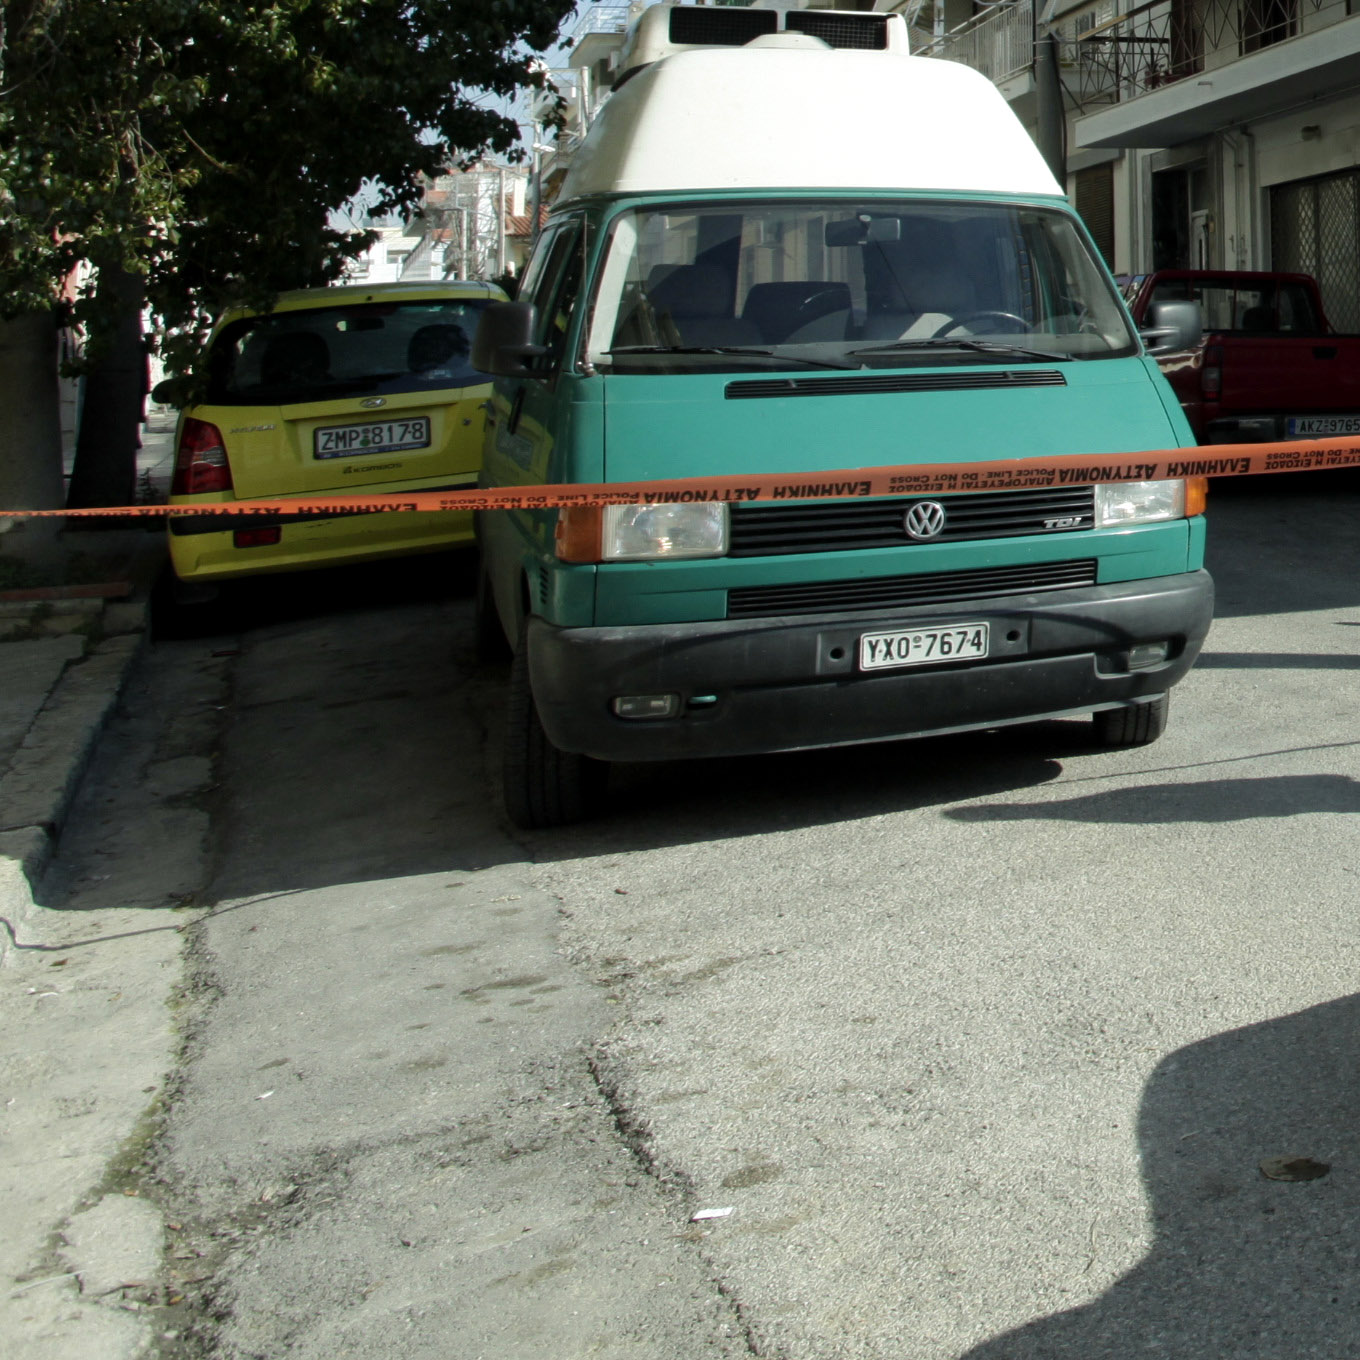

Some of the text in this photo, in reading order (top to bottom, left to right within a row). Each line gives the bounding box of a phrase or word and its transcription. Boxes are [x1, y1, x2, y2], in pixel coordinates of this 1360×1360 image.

[1266, 451, 1301, 461] CROSS
[1303, 450, 1324, 459] NOT
[1327, 448, 1343, 457] DO
[1264, 458, 1312, 471] ΕΙΣΟΔΟΣ
[1315, 458, 1324, 467] Η
[889, 468, 1056, 484] POLICE LINE DO NOT CROSS
[1058, 457, 1252, 483] ΕΛΛΗΝΙΚΗ ΑΣΤΥΝΟΜΙΑ
[888, 475, 1054, 493] ΑΠΑΓΟΡΕΥΕΤΑΙ Η ΕΙΣΟΔΟΣ
[439, 491, 640, 506] POLICE LINE DO NOT CROSS
[643, 481, 872, 504] ΕΛΛΗΝΙΚΗ ΑΣΤΥΝΟΜΙΑ
